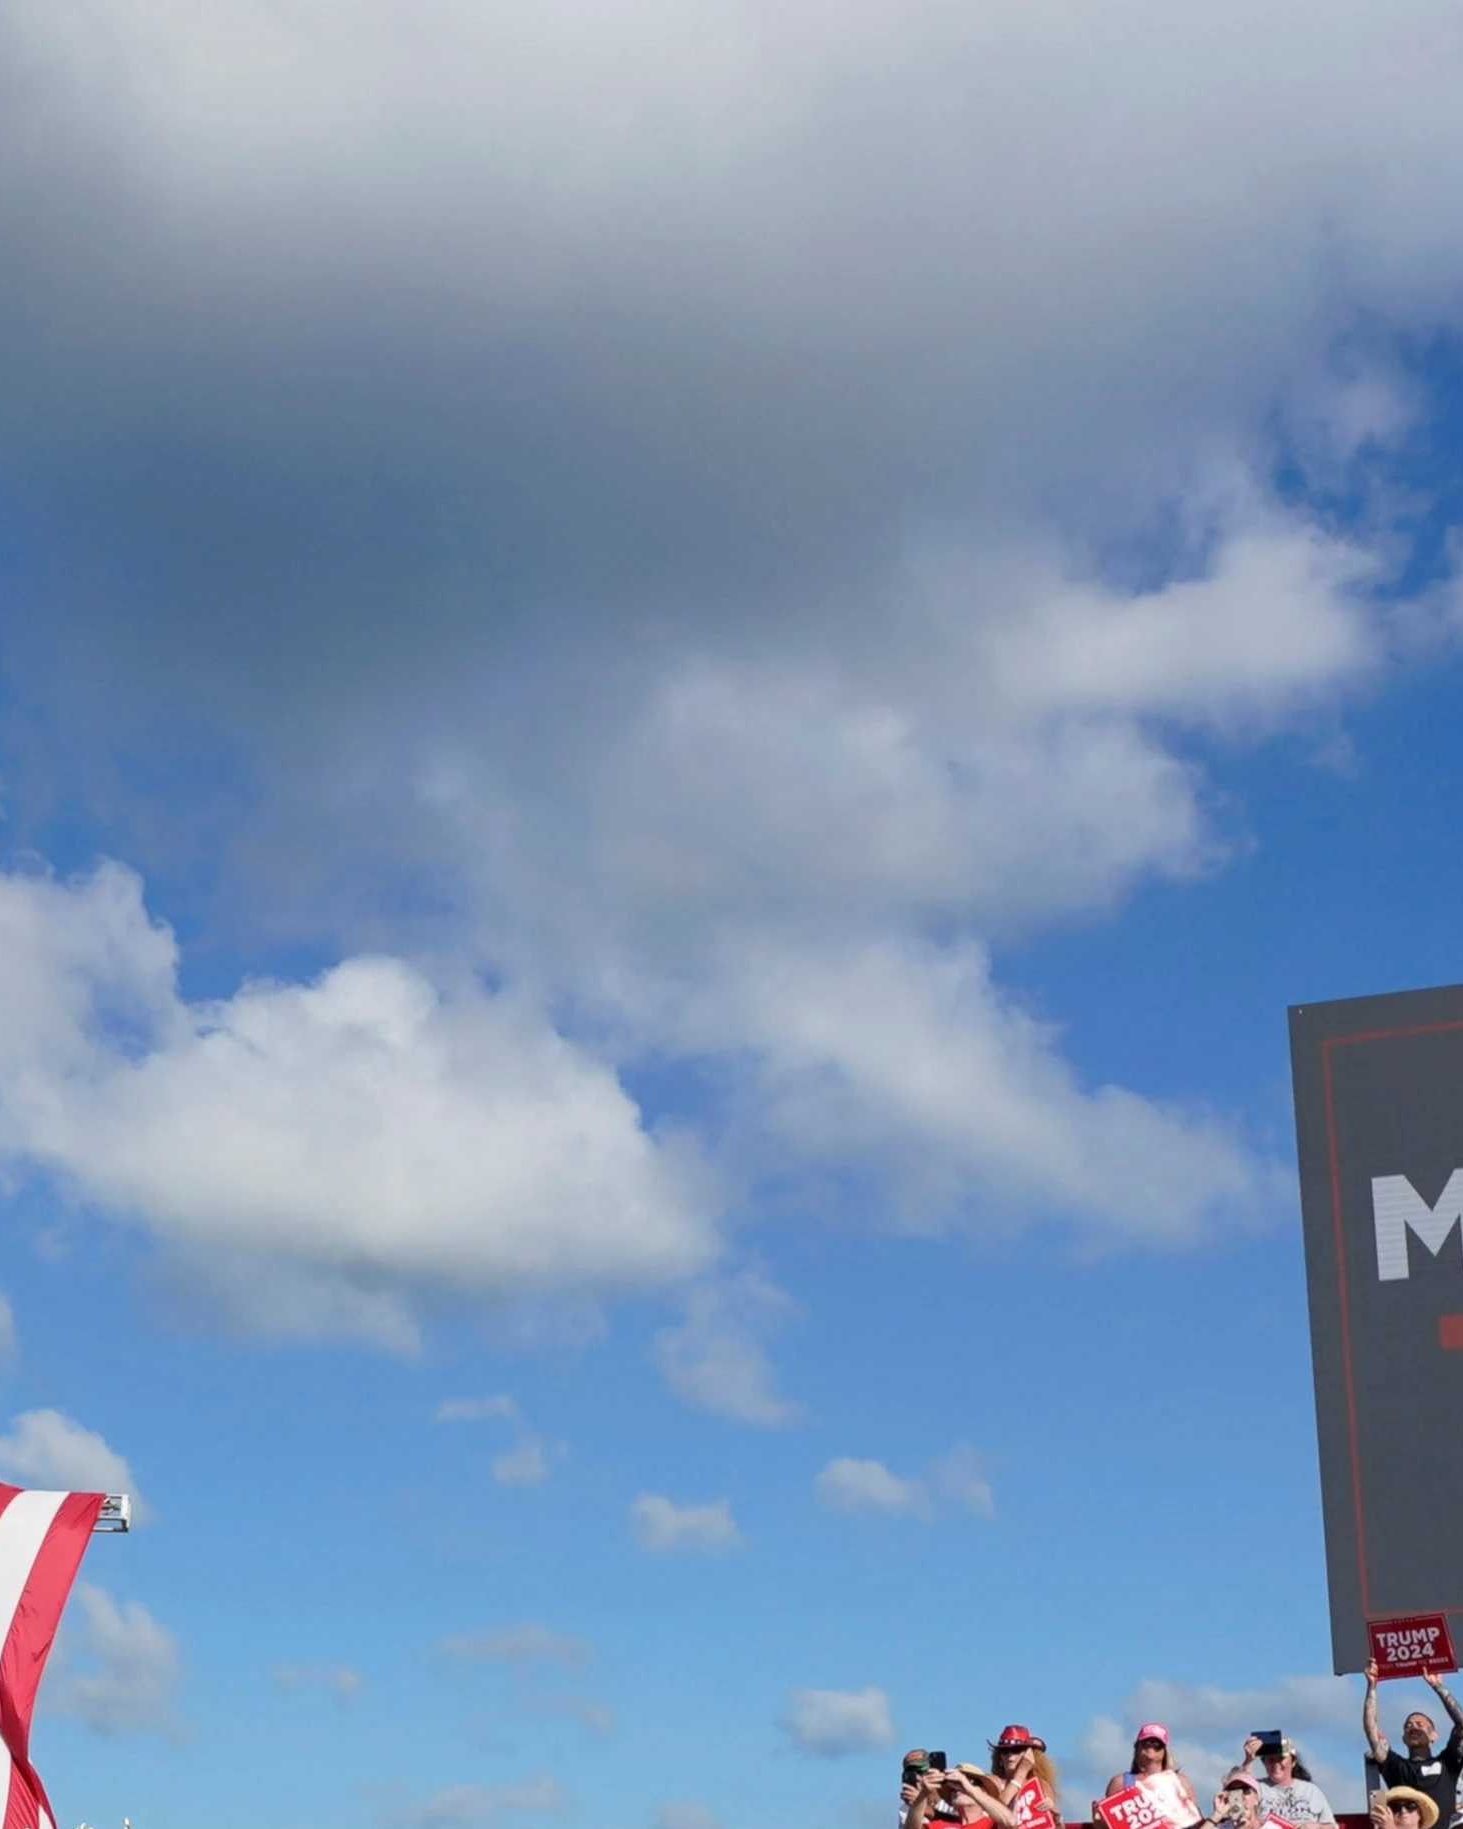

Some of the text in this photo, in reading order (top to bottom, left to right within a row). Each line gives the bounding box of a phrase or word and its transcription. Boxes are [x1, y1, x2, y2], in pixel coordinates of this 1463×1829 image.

[1375, 1627, 1440, 1648] TRUMP
[1386, 1642, 1435, 1663] 2024
[1109, 1792, 1151, 1821] TRU
